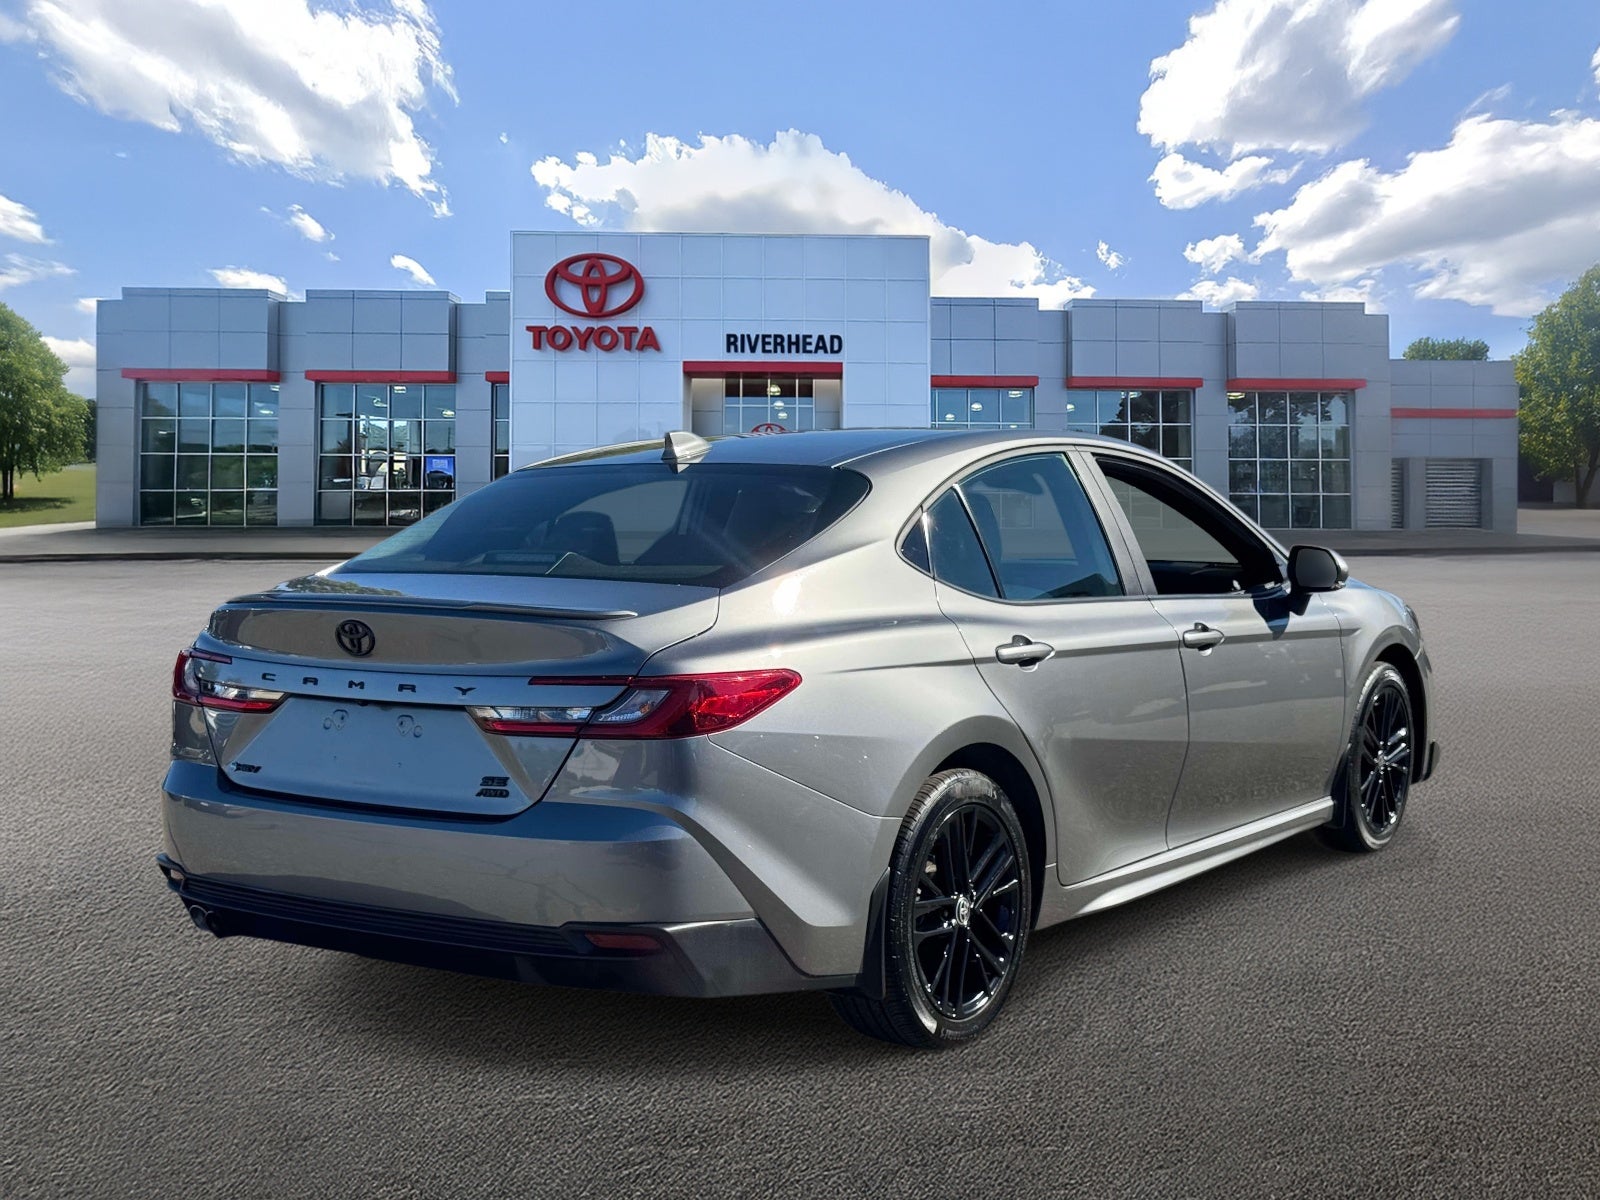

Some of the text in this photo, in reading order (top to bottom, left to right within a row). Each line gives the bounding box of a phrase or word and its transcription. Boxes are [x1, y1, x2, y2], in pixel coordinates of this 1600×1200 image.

[525, 325, 661, 352] TOYOTA
[726, 333, 843, 354] RIVERHEAD
[261, 672, 477, 696] CAMRY
[475, 788, 510, 798] AWD
